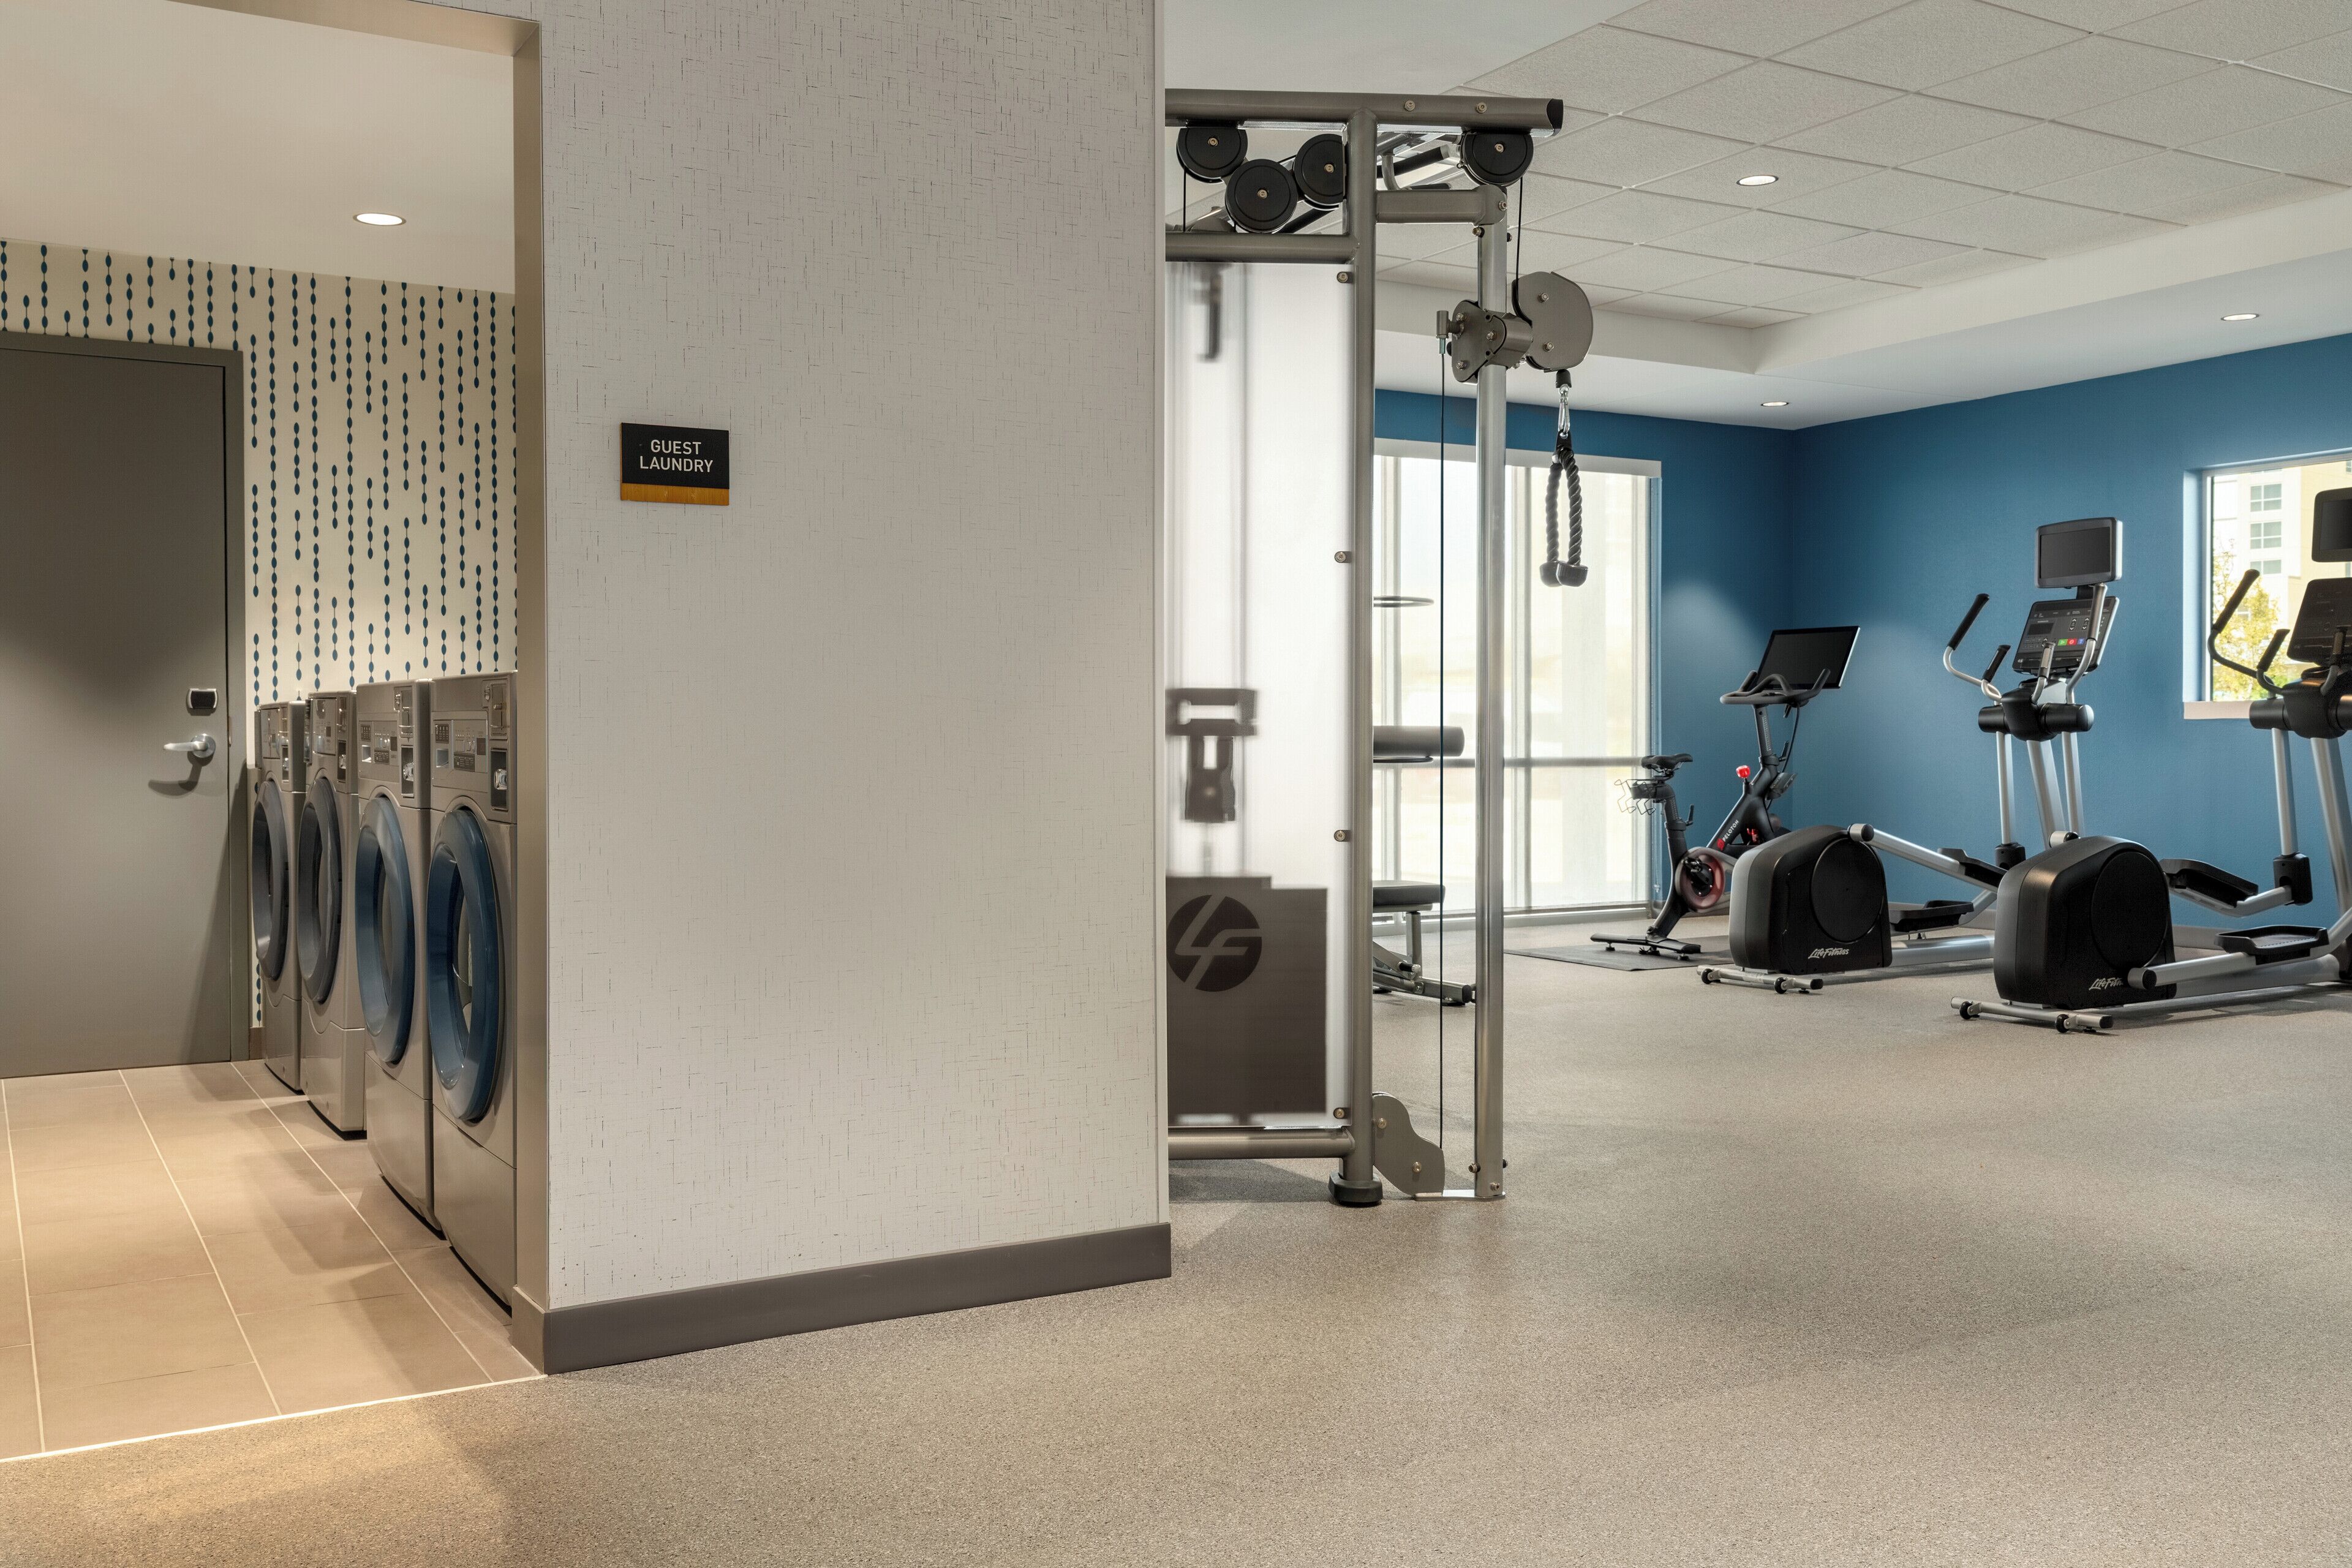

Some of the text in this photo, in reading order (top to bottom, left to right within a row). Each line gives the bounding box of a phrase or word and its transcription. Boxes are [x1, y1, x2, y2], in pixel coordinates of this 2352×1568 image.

[650, 439, 702, 455] GUEST
[639, 456, 714, 473] LAUNDRY
[1722, 819, 1740, 842] PELOTON
